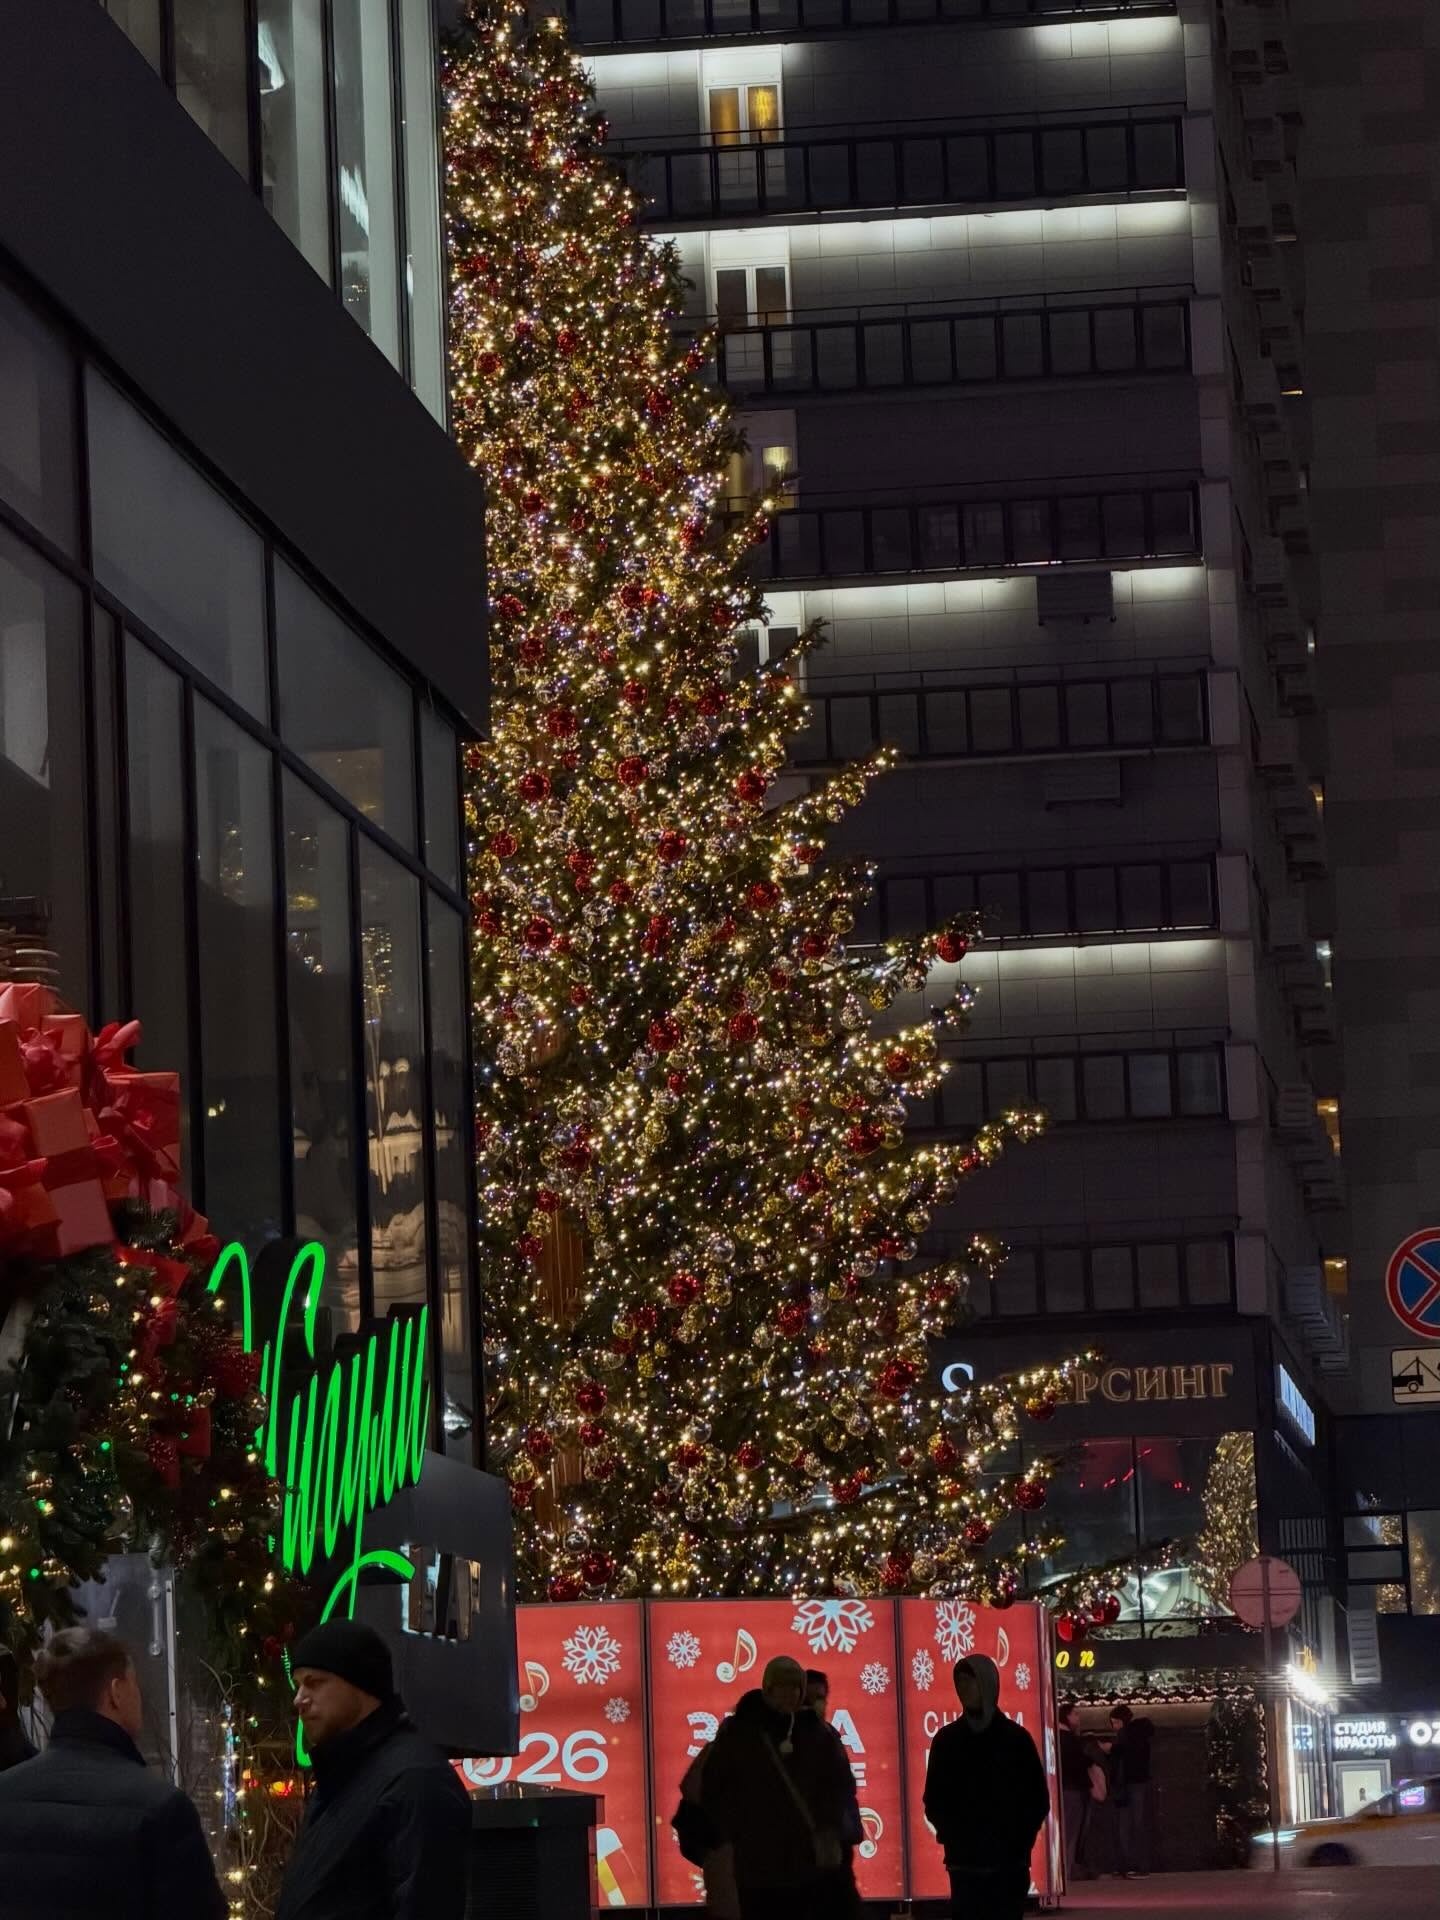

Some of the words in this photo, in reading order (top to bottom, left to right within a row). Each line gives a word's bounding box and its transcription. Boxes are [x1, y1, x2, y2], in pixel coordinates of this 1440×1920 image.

[1056, 1362, 1235, 1404] РСИНГ
[1334, 1721, 1387, 1737] СТУДИЯ
[1334, 1735, 1397, 1749] КРАСОТЫ
[462, 1730, 609, 1786] 026
